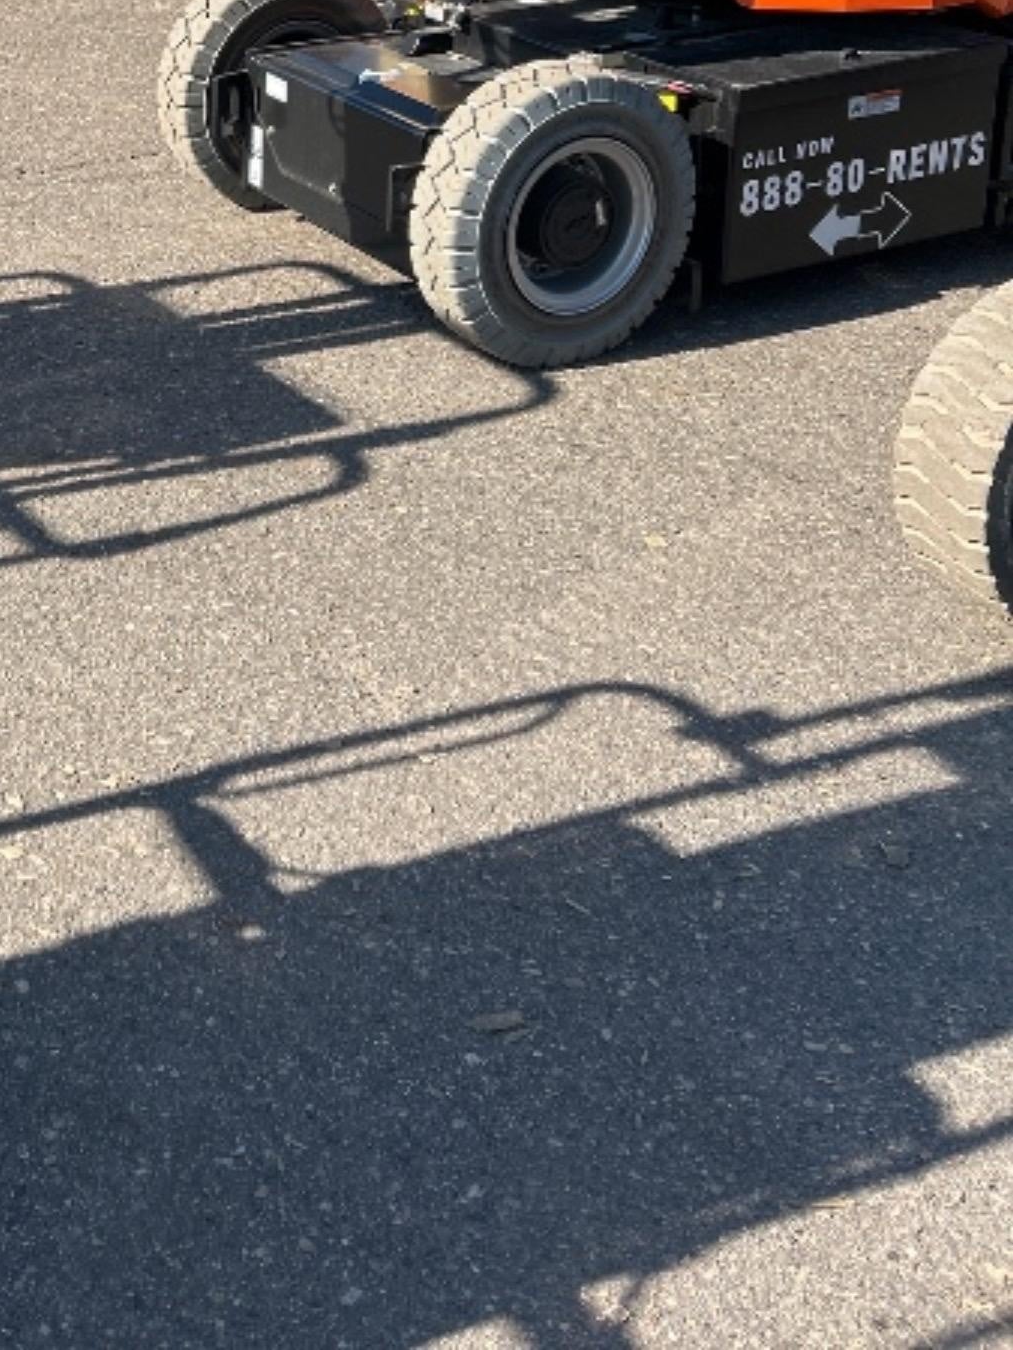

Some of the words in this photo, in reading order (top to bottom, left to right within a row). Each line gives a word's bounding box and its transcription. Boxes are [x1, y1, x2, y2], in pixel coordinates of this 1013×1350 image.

[740, 131, 986, 217] 888-80-RENTS
[742, 146, 786, 169] CALL
[796, 136, 834, 159] NOW
